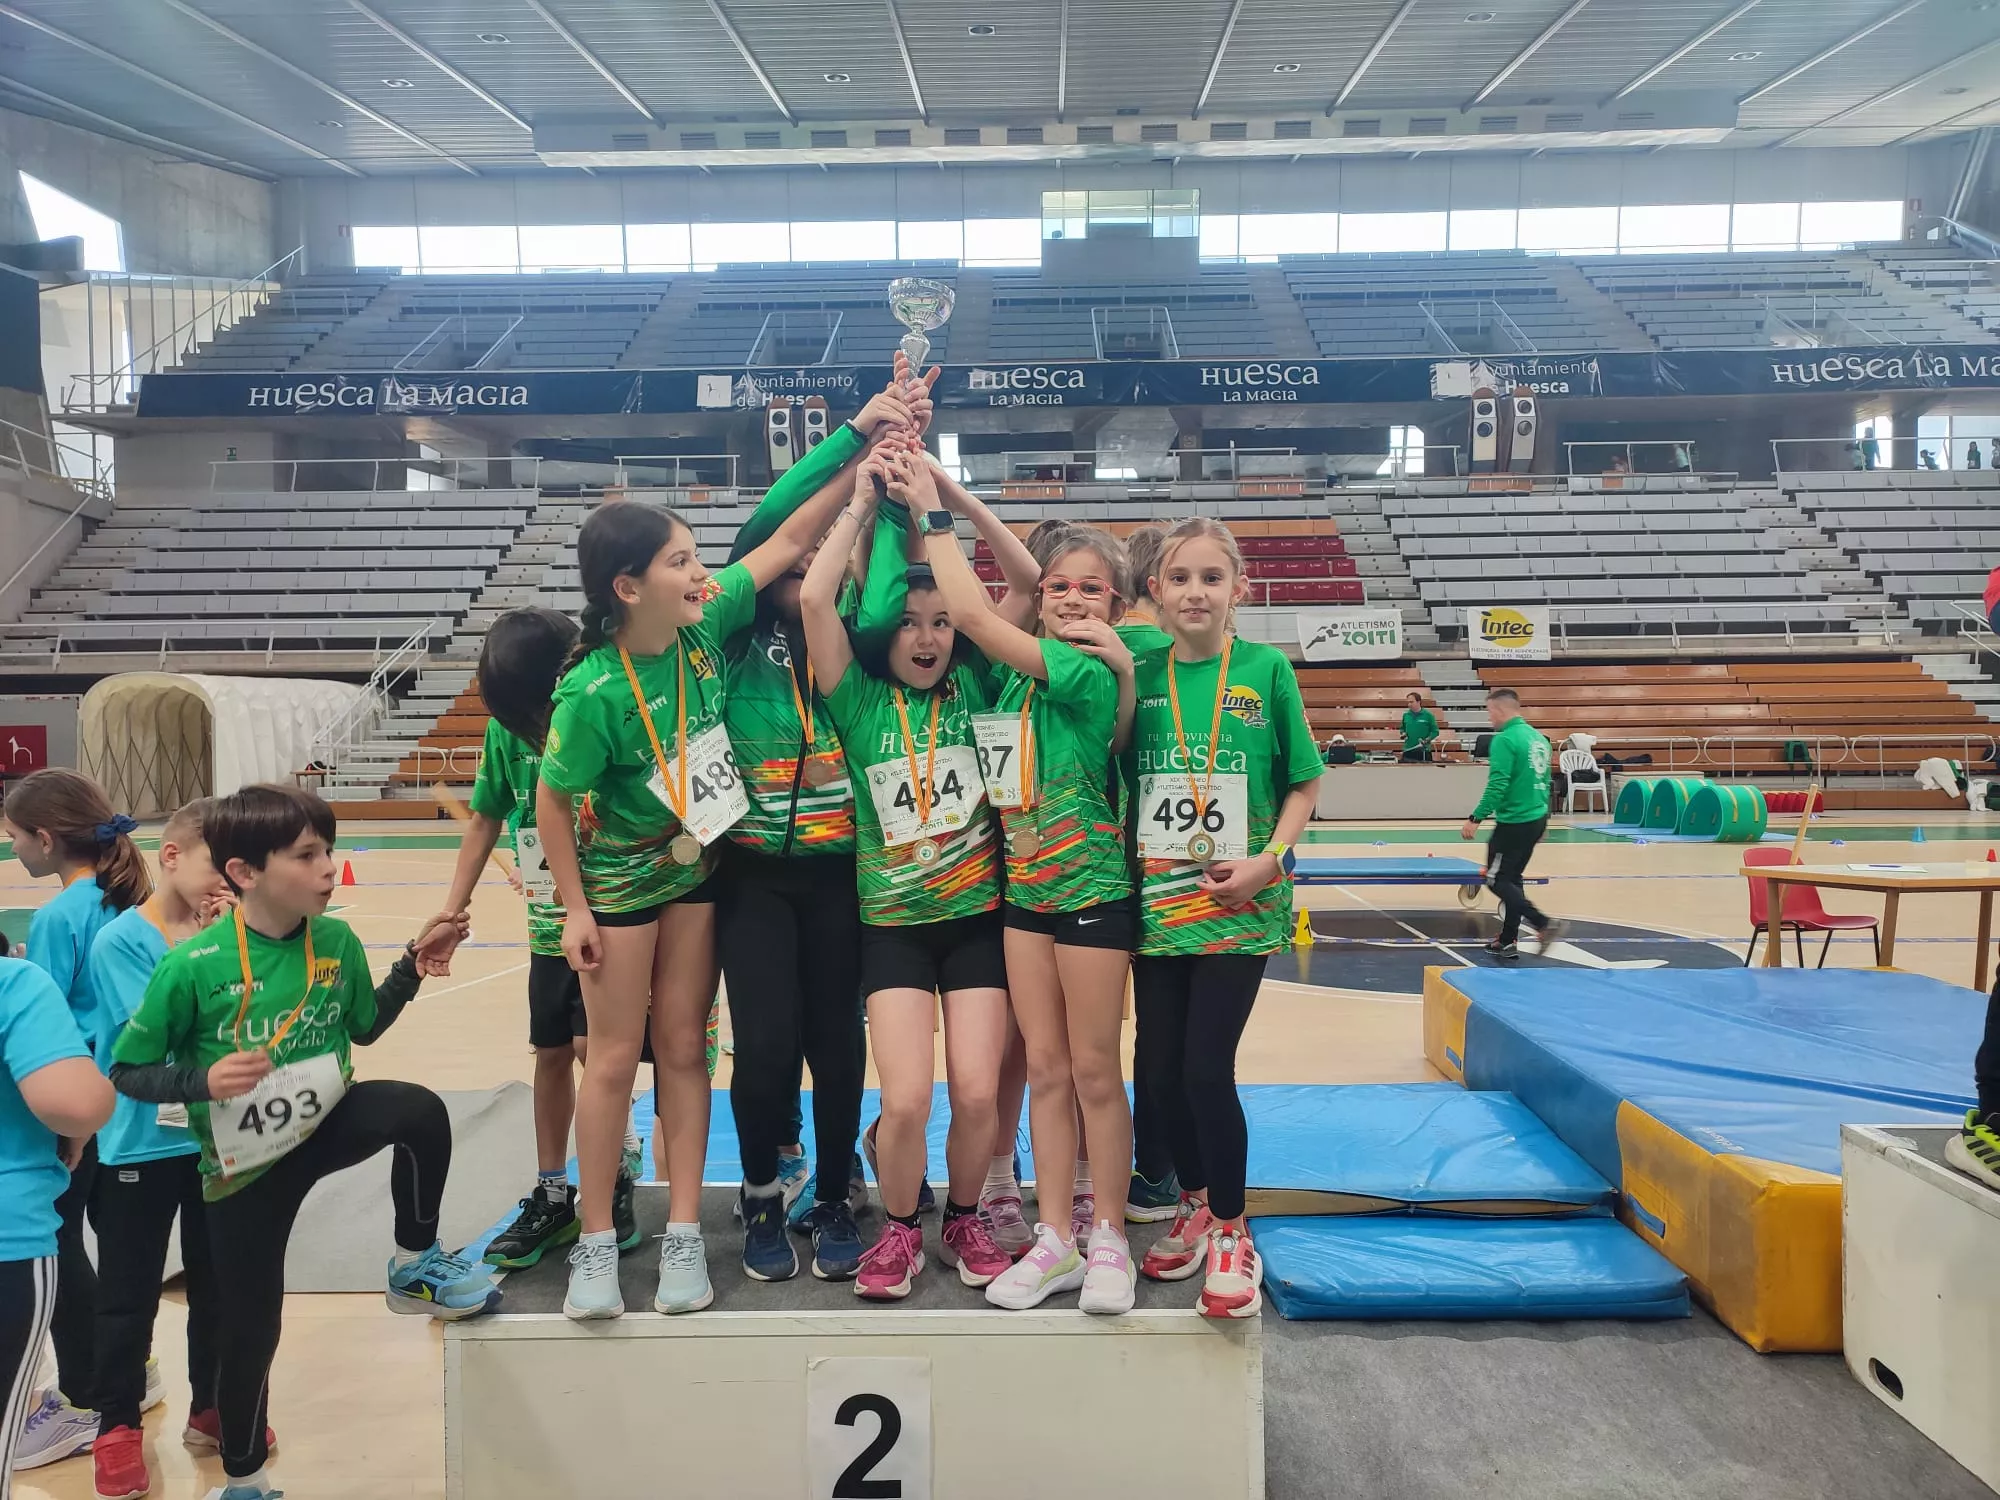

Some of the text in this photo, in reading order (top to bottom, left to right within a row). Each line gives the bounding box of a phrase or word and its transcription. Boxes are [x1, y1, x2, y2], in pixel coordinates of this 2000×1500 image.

[1489, 360, 1598, 376] yuntamiento
[1505, 379, 1570, 394] Hesca
[1340, 620, 1396, 630] ATLETISMO
[1341, 629, 1396, 646] ZOITI
[1153, 797, 1225, 833] 496
[230, 981, 264, 996] ZOTI
[238, 1089, 322, 1136] 493
[1092, 1249, 1120, 1264] NIKE
[831, 1393, 902, 1498] 2
